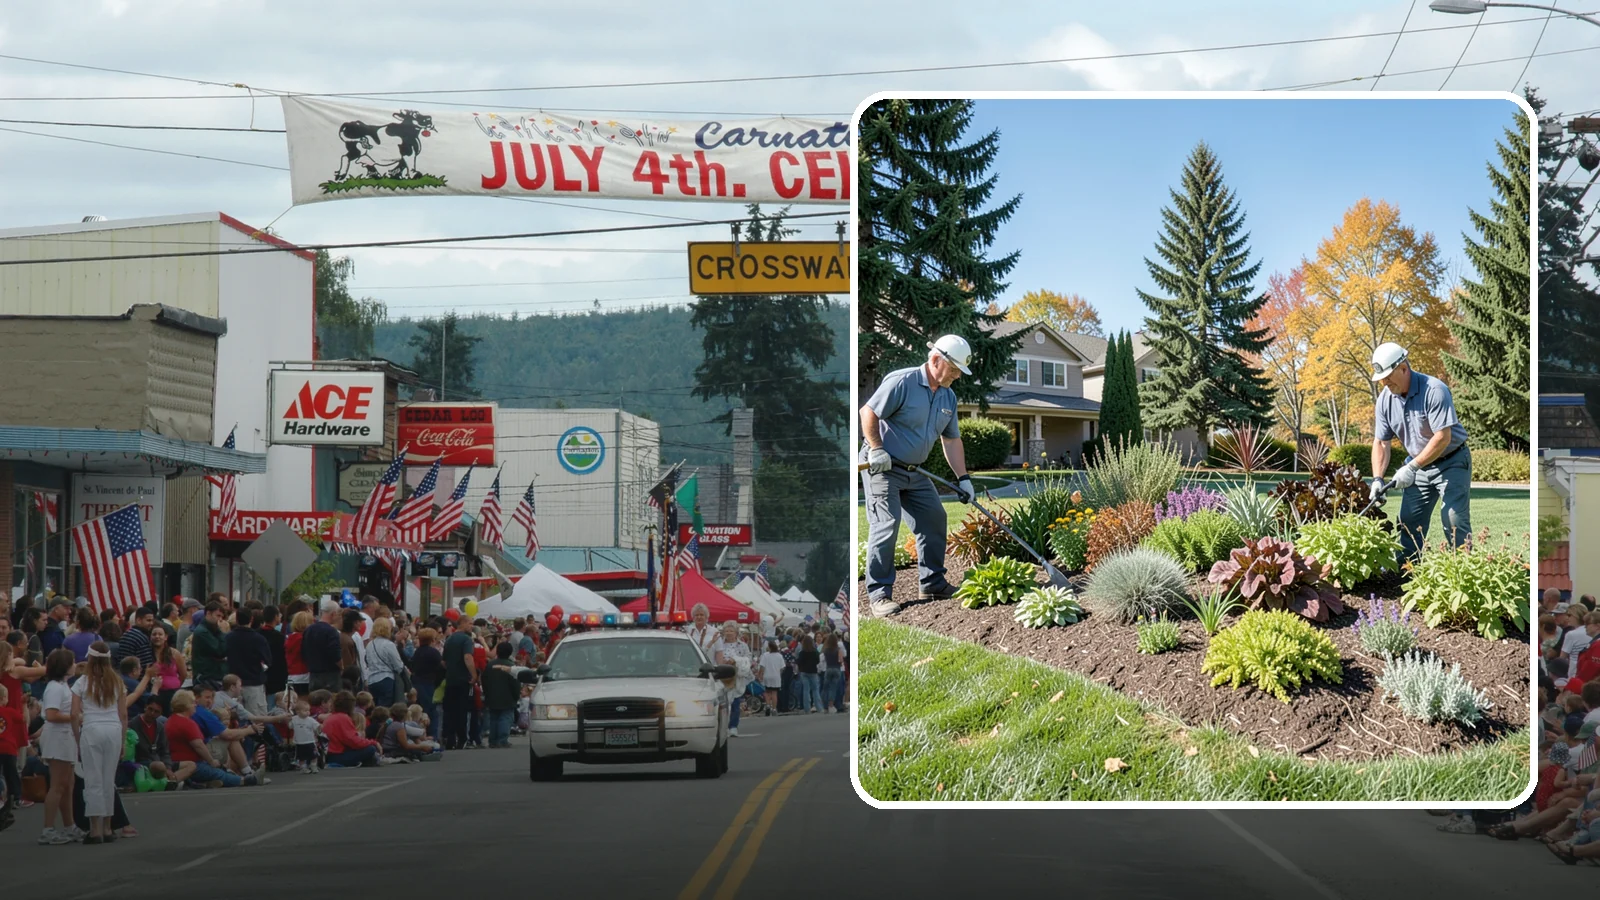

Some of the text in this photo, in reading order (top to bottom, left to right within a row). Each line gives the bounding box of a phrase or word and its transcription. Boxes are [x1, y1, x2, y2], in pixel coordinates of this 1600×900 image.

[481, 141, 605, 192] JULY
[632, 150, 746, 198] 4th.
[697, 254, 850, 280] CROSSWA
[283, 380, 373, 420] ACE
[405, 409, 452, 422] CEDAR
[283, 421, 370, 436] Hardware
[416, 428, 476, 447] Coca-Cola
[95, 485, 124, 495] Vincent
[126, 486, 136, 495] de
[137, 486, 155, 495] Paul
[688, 526, 741, 535] CRNATION
[699, 535, 730, 543] GLASS
